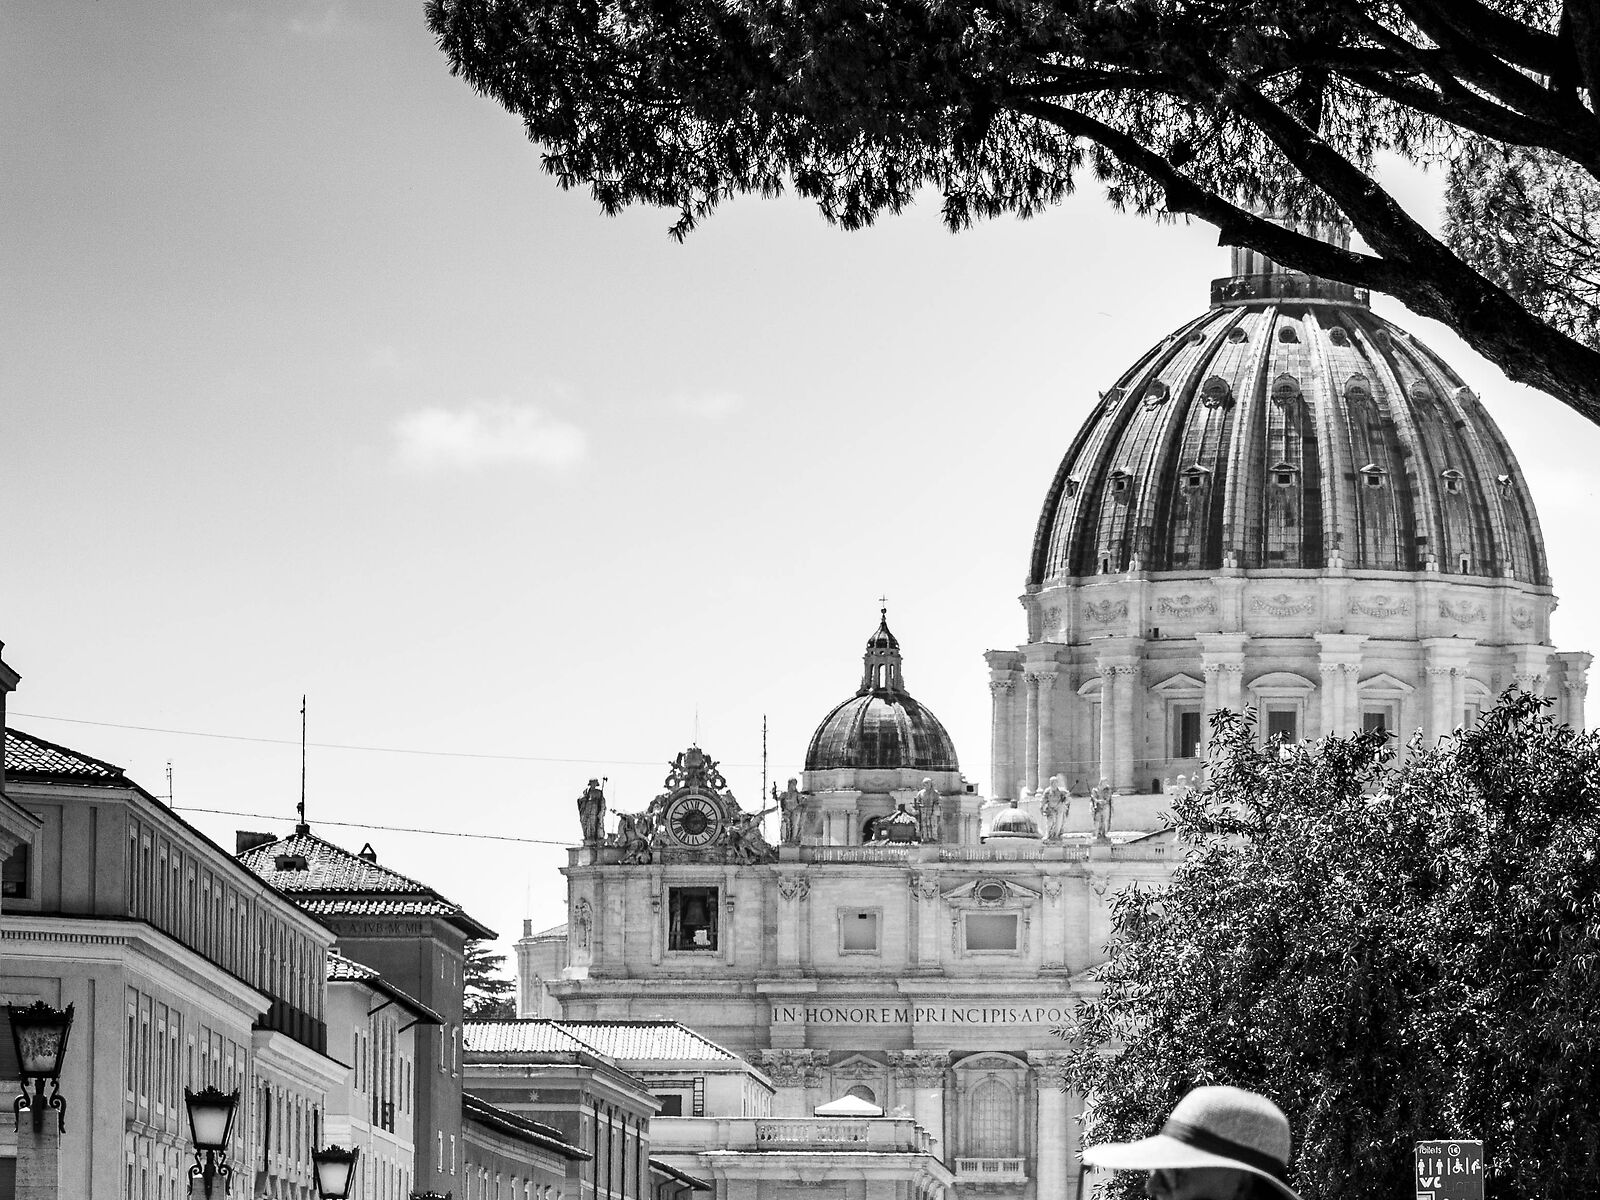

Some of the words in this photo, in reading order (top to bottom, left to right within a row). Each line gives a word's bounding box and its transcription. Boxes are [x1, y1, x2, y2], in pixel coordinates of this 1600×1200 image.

[773, 1007, 796, 1023] IN
[805, 1007, 910, 1023] HONOREM
[915, 1007, 1017, 1023] PRINCIPIS
[1419, 1176, 1442, 1189] WC
